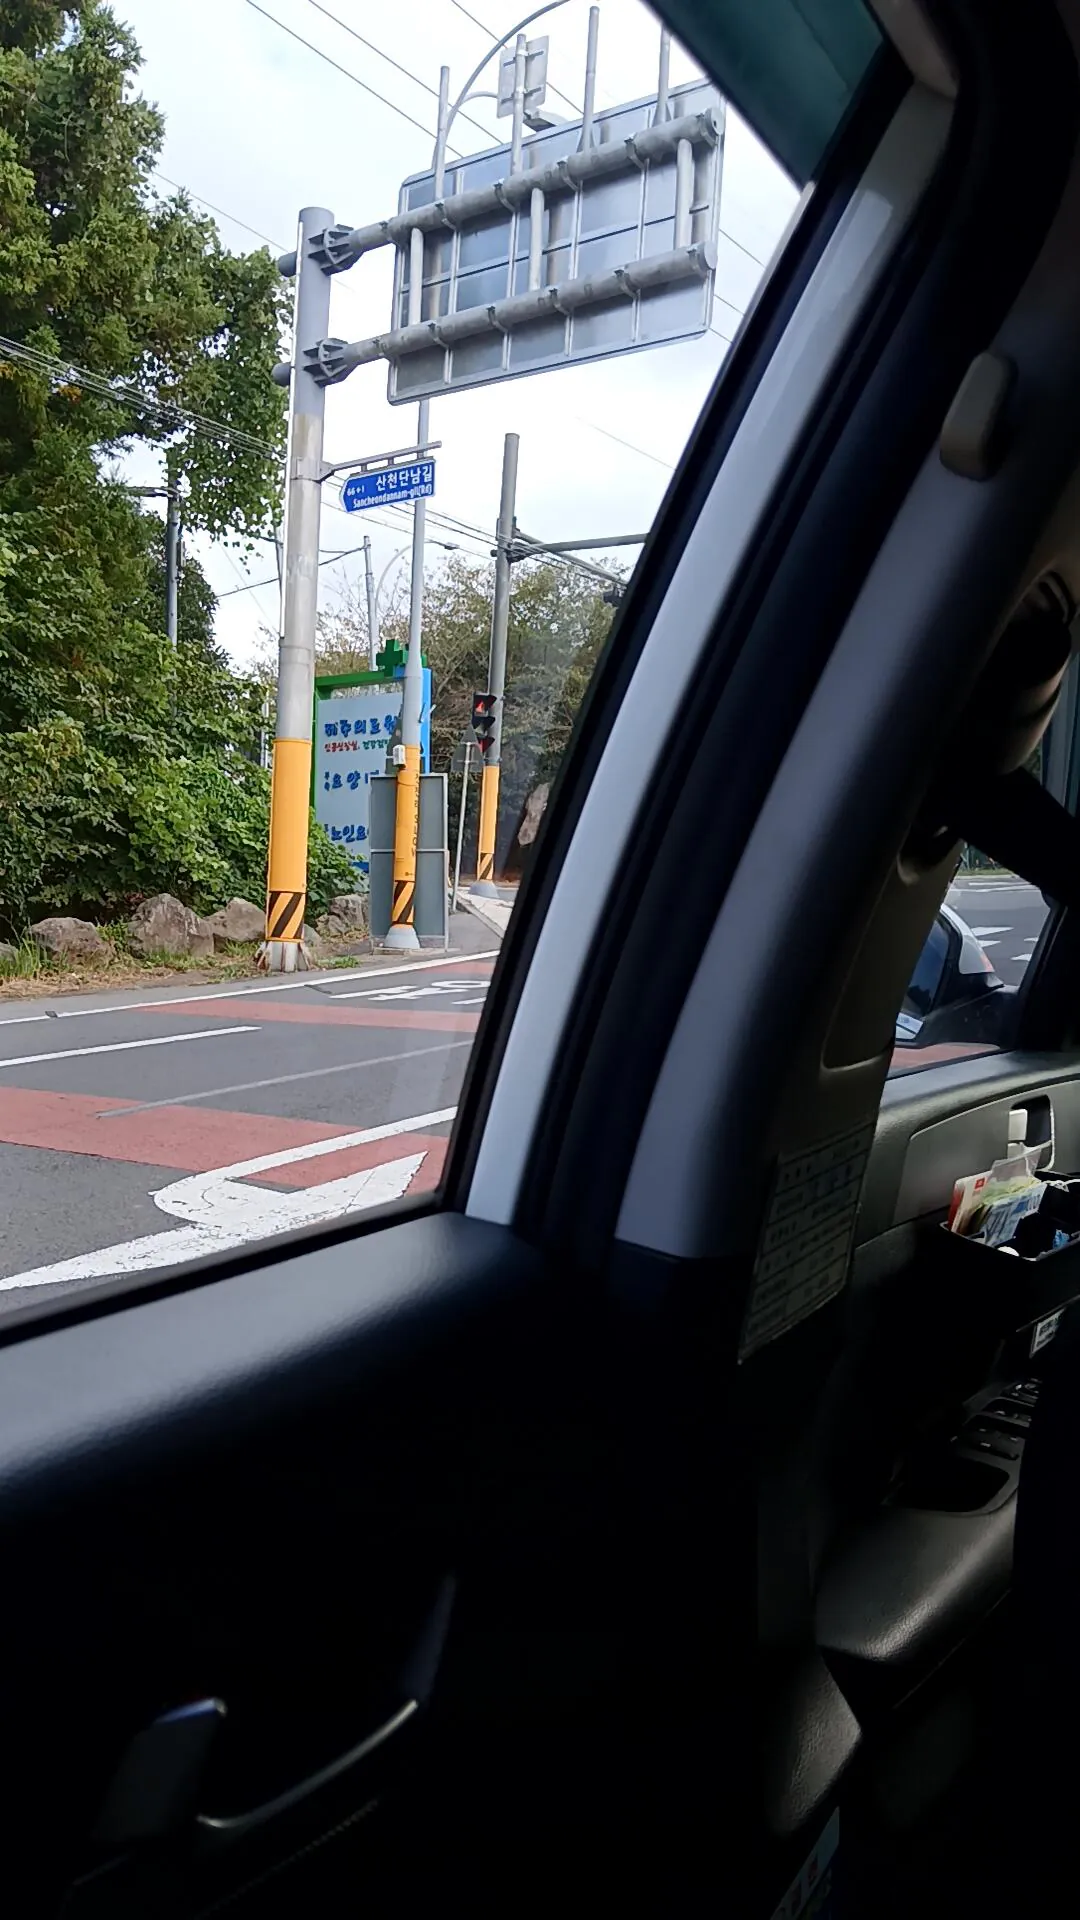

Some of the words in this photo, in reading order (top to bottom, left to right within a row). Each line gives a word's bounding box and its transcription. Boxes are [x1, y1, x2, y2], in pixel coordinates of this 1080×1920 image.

[376, 464, 433, 491] 산천단남길
[332, 770, 380, 790] 요양
[331, 824, 370, 844] 노인요
